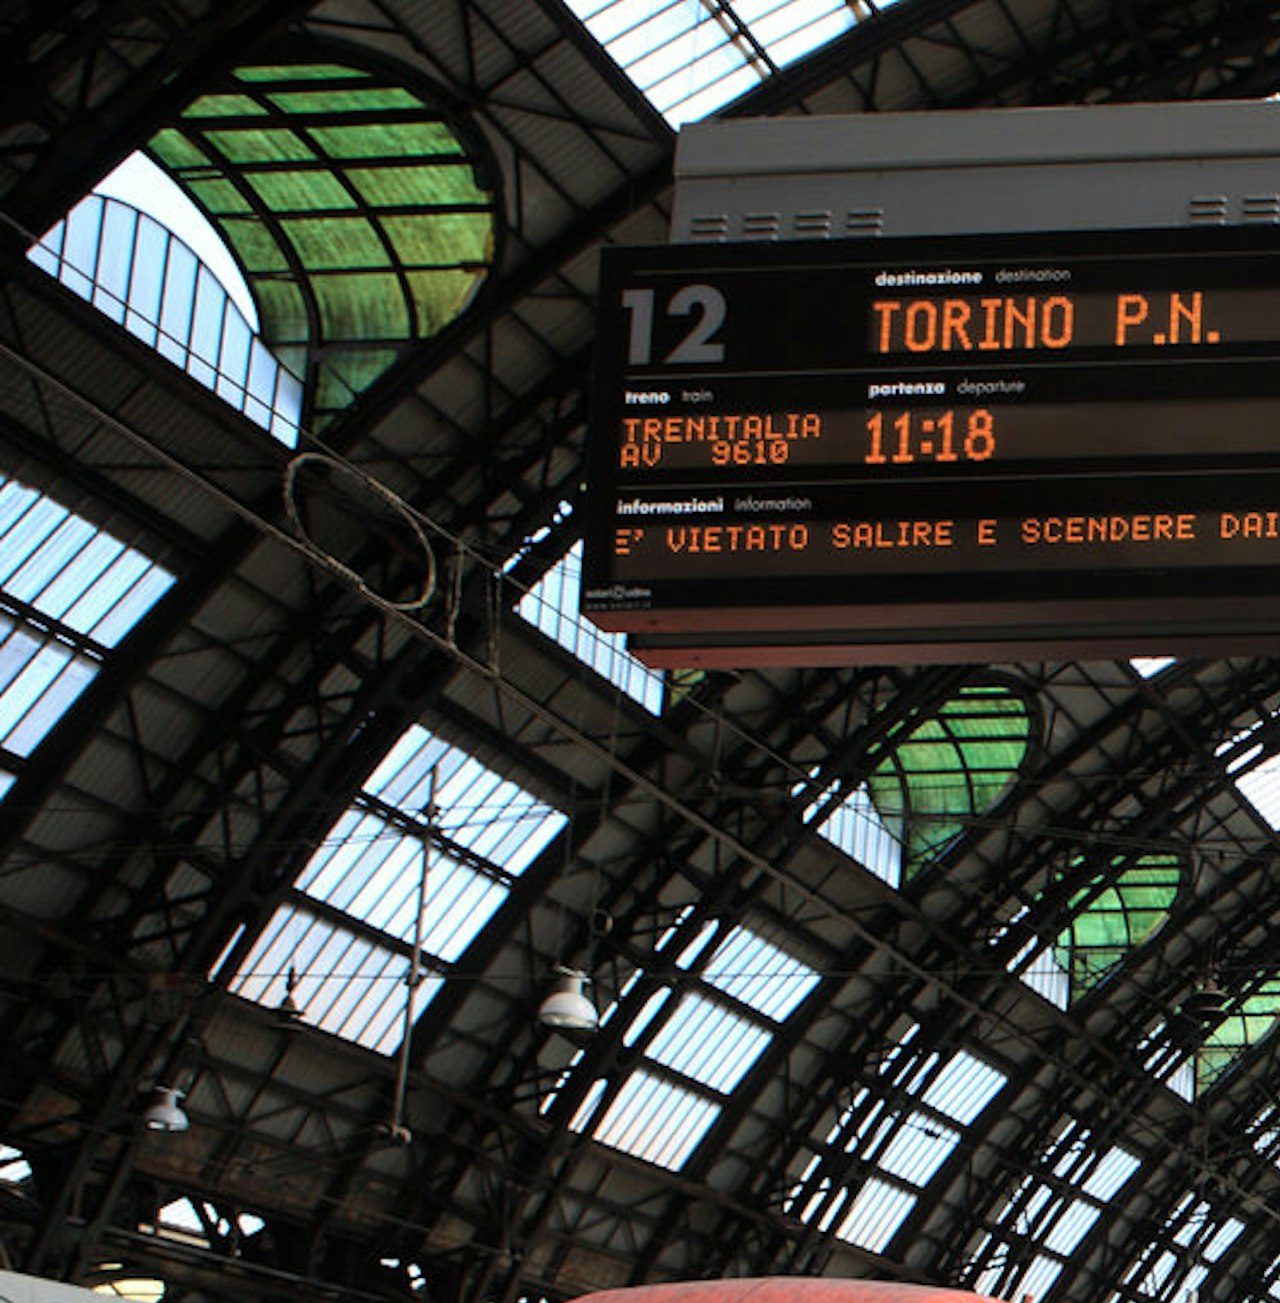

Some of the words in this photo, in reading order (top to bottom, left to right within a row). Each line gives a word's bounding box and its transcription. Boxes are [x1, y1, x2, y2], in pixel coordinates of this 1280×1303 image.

[875, 270, 983, 286] destinazione
[995, 268, 1071, 284] destination
[622, 284, 727, 365] 12
[873, 295, 1074, 353] TORINO
[1115, 291, 1221, 346] P.N.
[625, 390, 670, 404] treno
[682, 389, 713, 402] train
[868, 381, 945, 399] partenza
[957, 378, 1025, 396] departure
[623, 413, 822, 443] TRENITALIA
[865, 408, 995, 465] 11:18
[620, 443, 662, 468] AV
[711, 440, 789, 465] 9610
[617, 498, 724, 515] informazioni
[735, 496, 811, 513] information
[666, 525, 809, 554] VIETATO
[832, 521, 954, 549] SALIRE
[978, 519, 997, 545] E
[1021, 513, 1197, 545] SCENDERE
[1220, 511, 1279, 540] DAI
